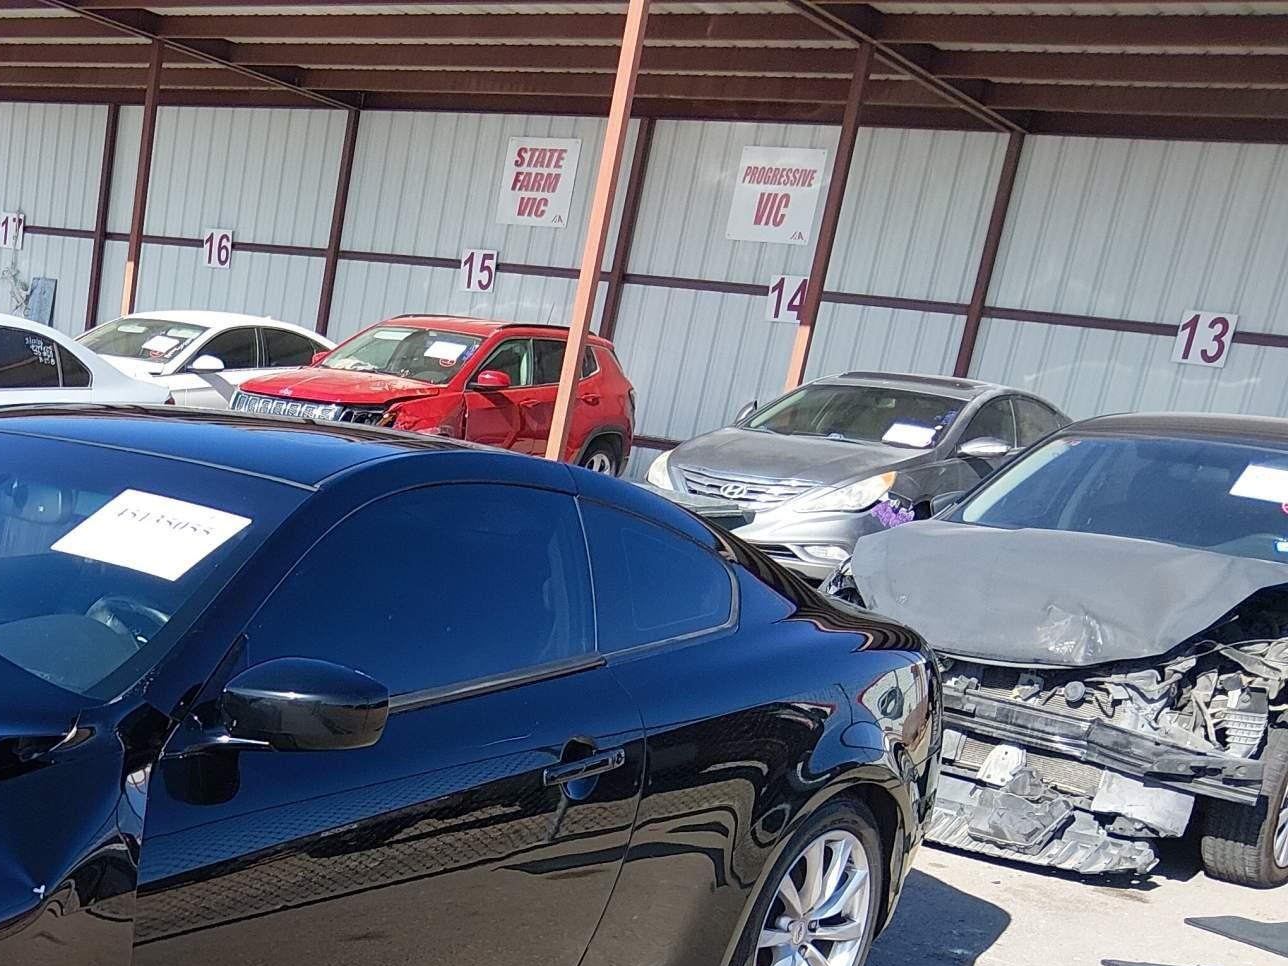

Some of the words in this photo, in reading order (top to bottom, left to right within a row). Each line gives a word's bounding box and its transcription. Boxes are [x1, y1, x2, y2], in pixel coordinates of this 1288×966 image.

[514, 147, 568, 169] STATE
[511, 172, 561, 193] FARM
[742, 166, 818, 187] PROGRESSIVE
[517, 197, 549, 218] VIC
[753, 192, 791, 227] VIC
[205, 232, 230, 266] 16
[463, 252, 494, 290] 15
[771, 277, 808, 320] 14
[1180, 314, 1229, 363] 13
